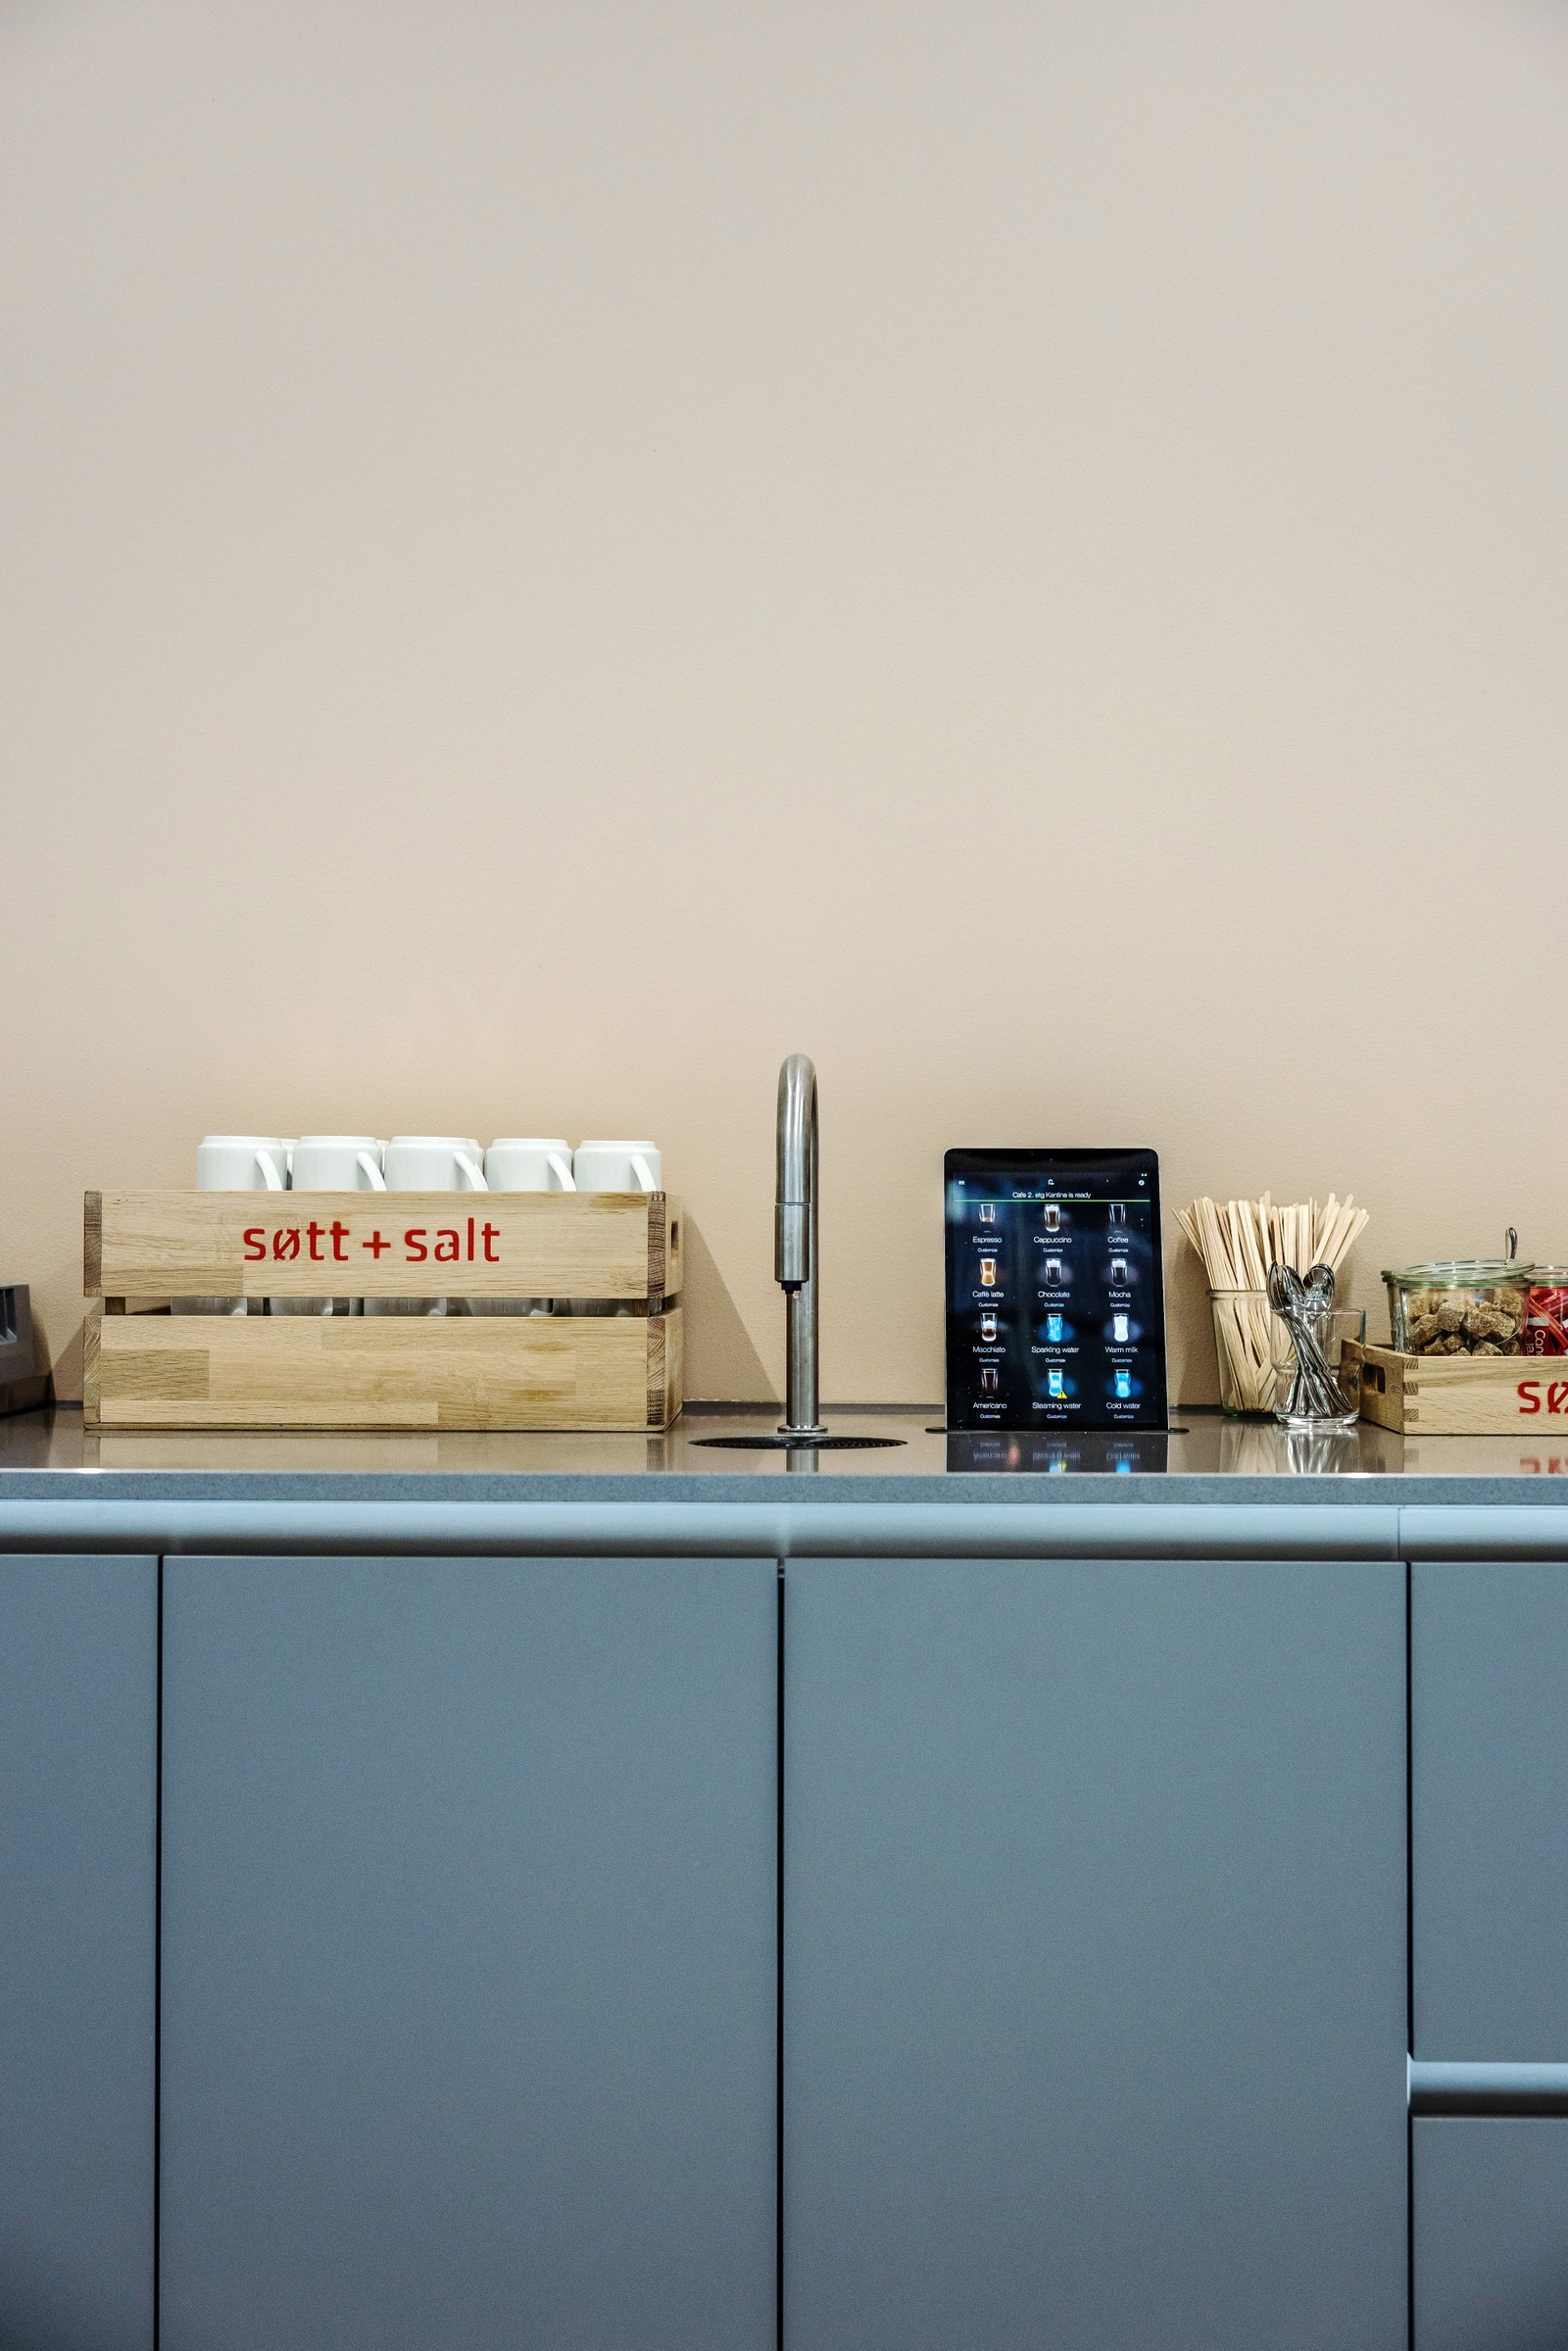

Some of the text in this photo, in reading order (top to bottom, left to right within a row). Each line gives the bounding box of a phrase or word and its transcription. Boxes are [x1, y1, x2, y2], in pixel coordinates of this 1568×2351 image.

[243, 1217, 500, 1261] søtt + salt
